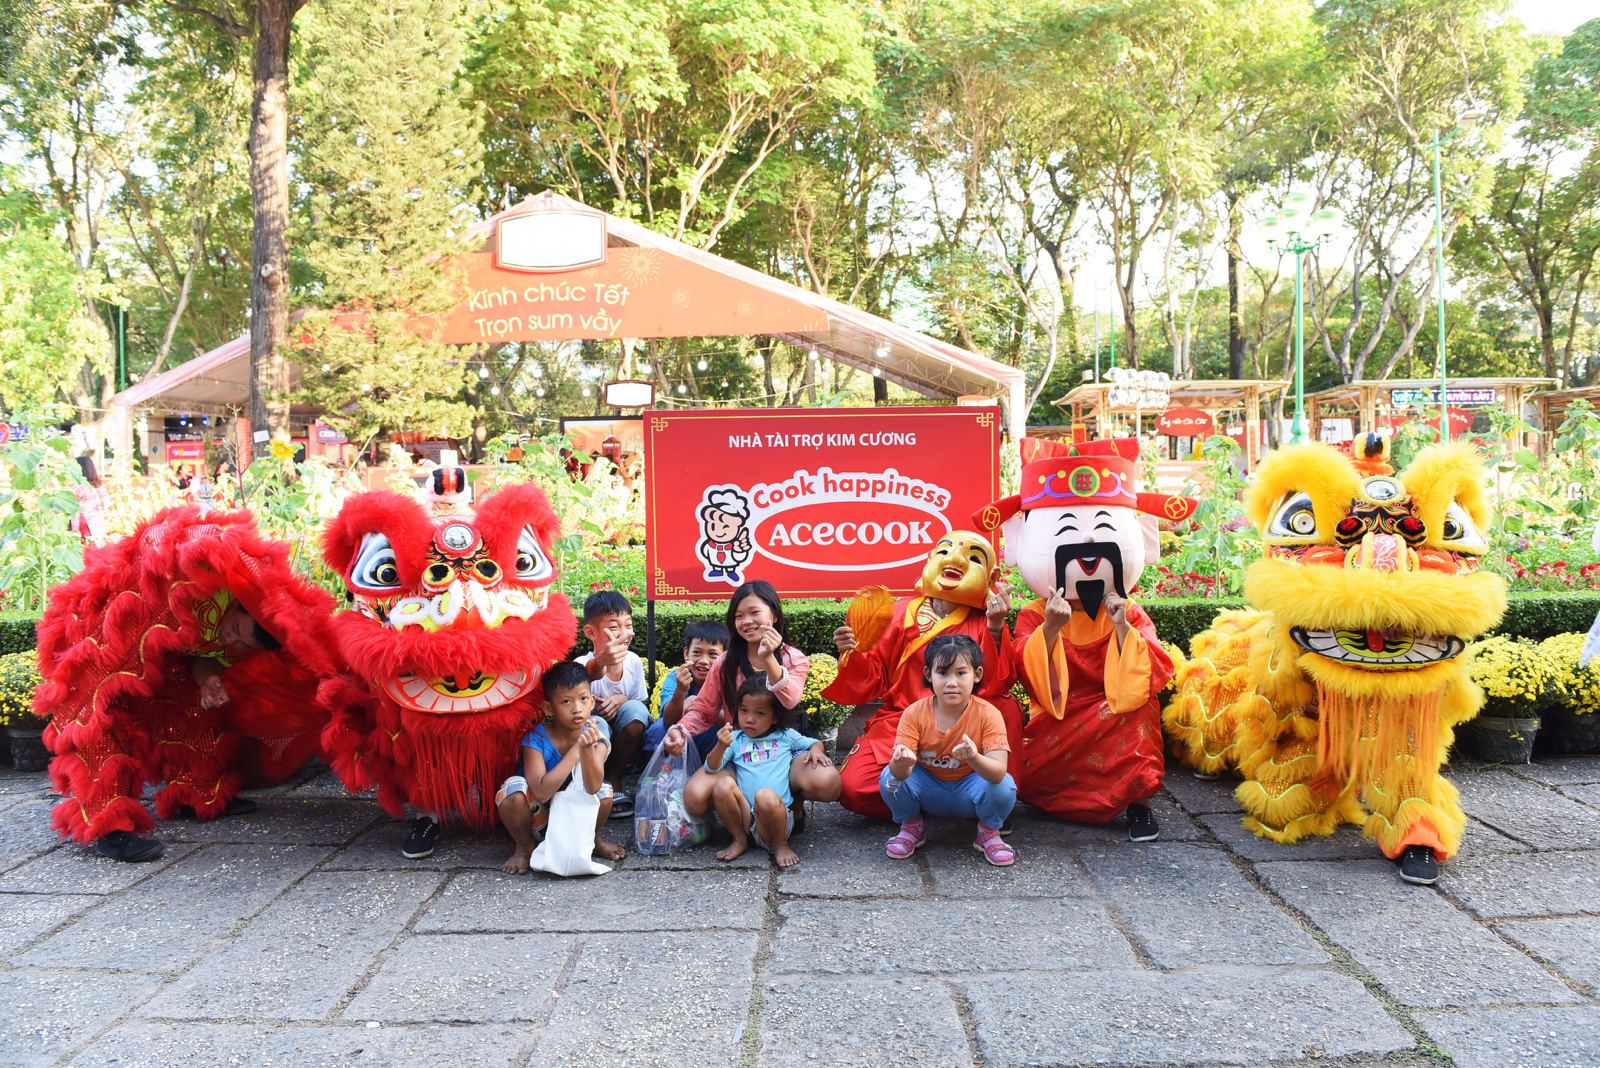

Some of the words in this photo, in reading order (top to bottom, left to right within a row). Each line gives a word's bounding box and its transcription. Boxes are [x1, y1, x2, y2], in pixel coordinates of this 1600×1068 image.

[468, 286, 518, 312] Kính
[524, 281, 586, 303] chúc
[593, 283, 631, 306] Tết
[475, 316, 522, 338] Trọn
[528, 313, 573, 330] sum
[579, 308, 622, 337] vầy
[728, 431, 763, 448] NHÀ
[765, 431, 789, 447] TÀI
[791, 432, 824, 450] TRỢ
[827, 433, 856, 446] KIM
[859, 431, 917, 446] CƯƠNG
[753, 475, 816, 509] Cook
[823, 473, 947, 508] happiness
[741, 740, 770, 753] SMALL
[771, 738, 779, 748] &
